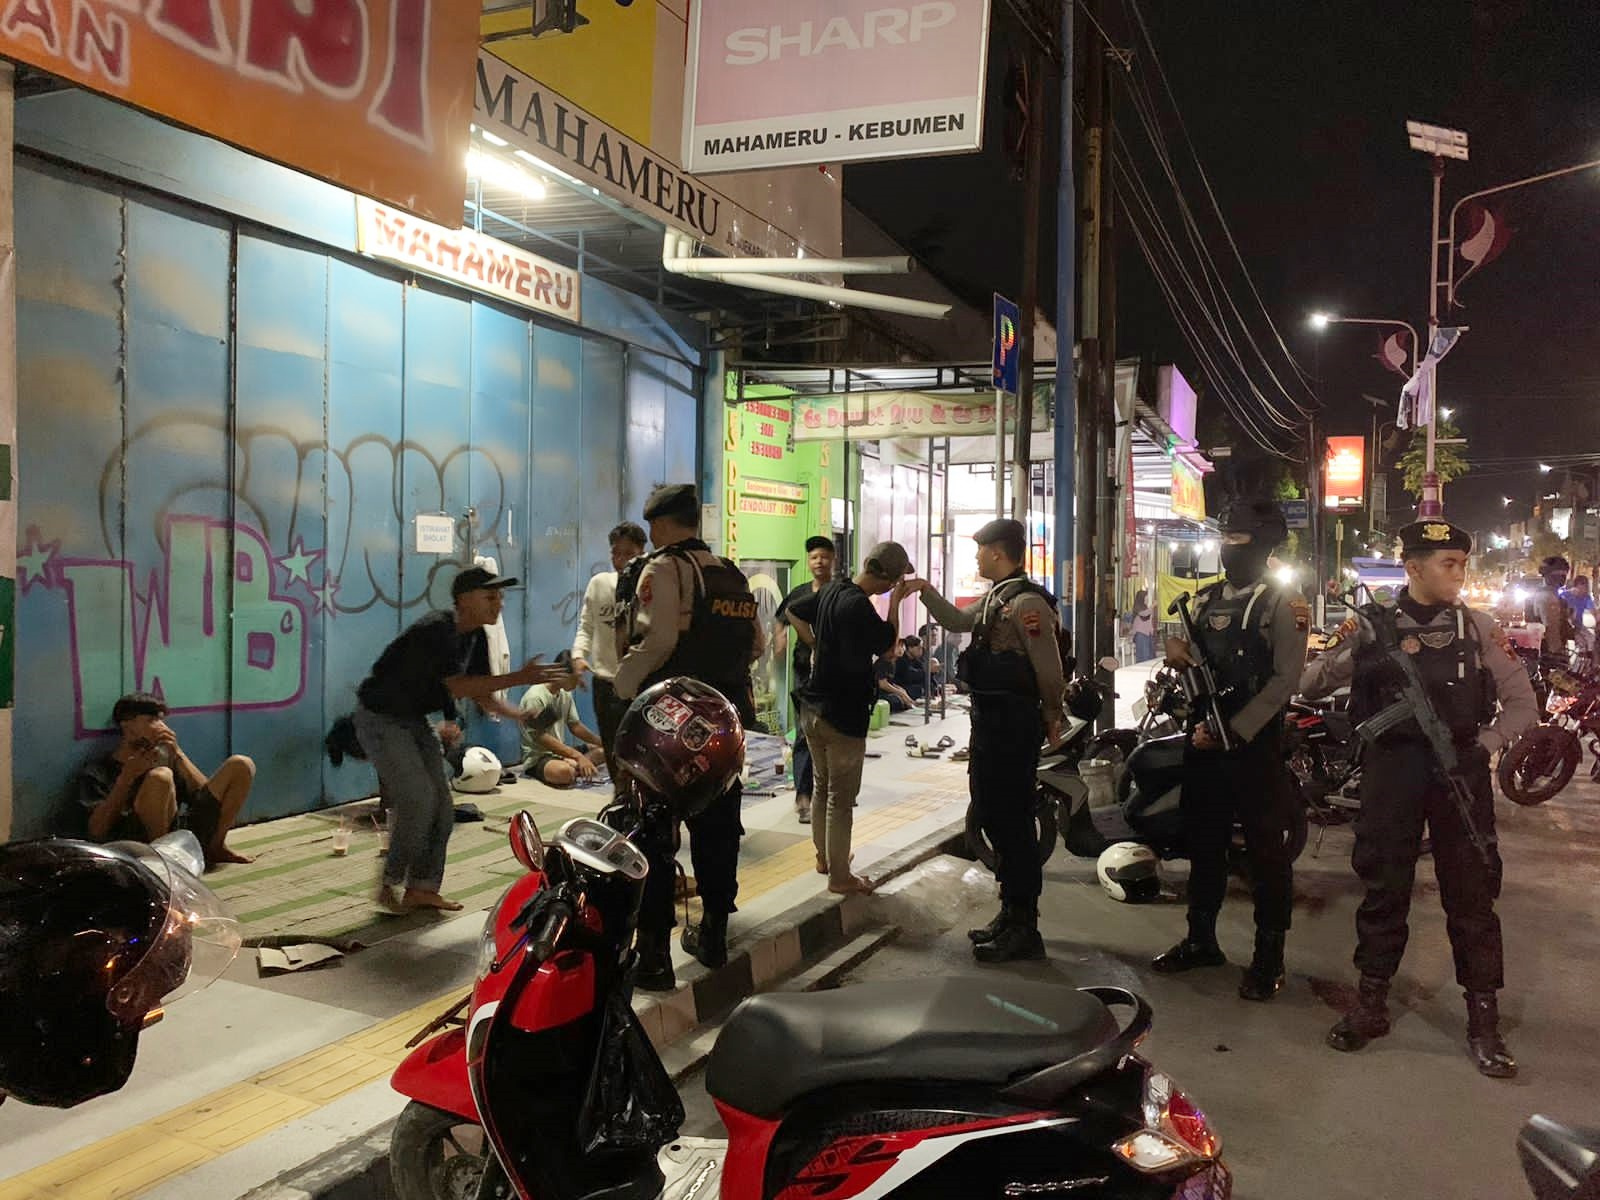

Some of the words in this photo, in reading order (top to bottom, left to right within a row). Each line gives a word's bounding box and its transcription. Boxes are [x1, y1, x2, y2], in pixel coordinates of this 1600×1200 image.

[725, 3, 956, 66] SHARP
[472, 57, 721, 237] MAHAMERU
[703, 127, 828, 156] MAHAMERU
[848, 112, 965, 141] KEBUMEN
[375, 208, 573, 310] MAHAMERU
[999, 313, 1015, 367] P
[711, 598, 757, 618] POLISI
